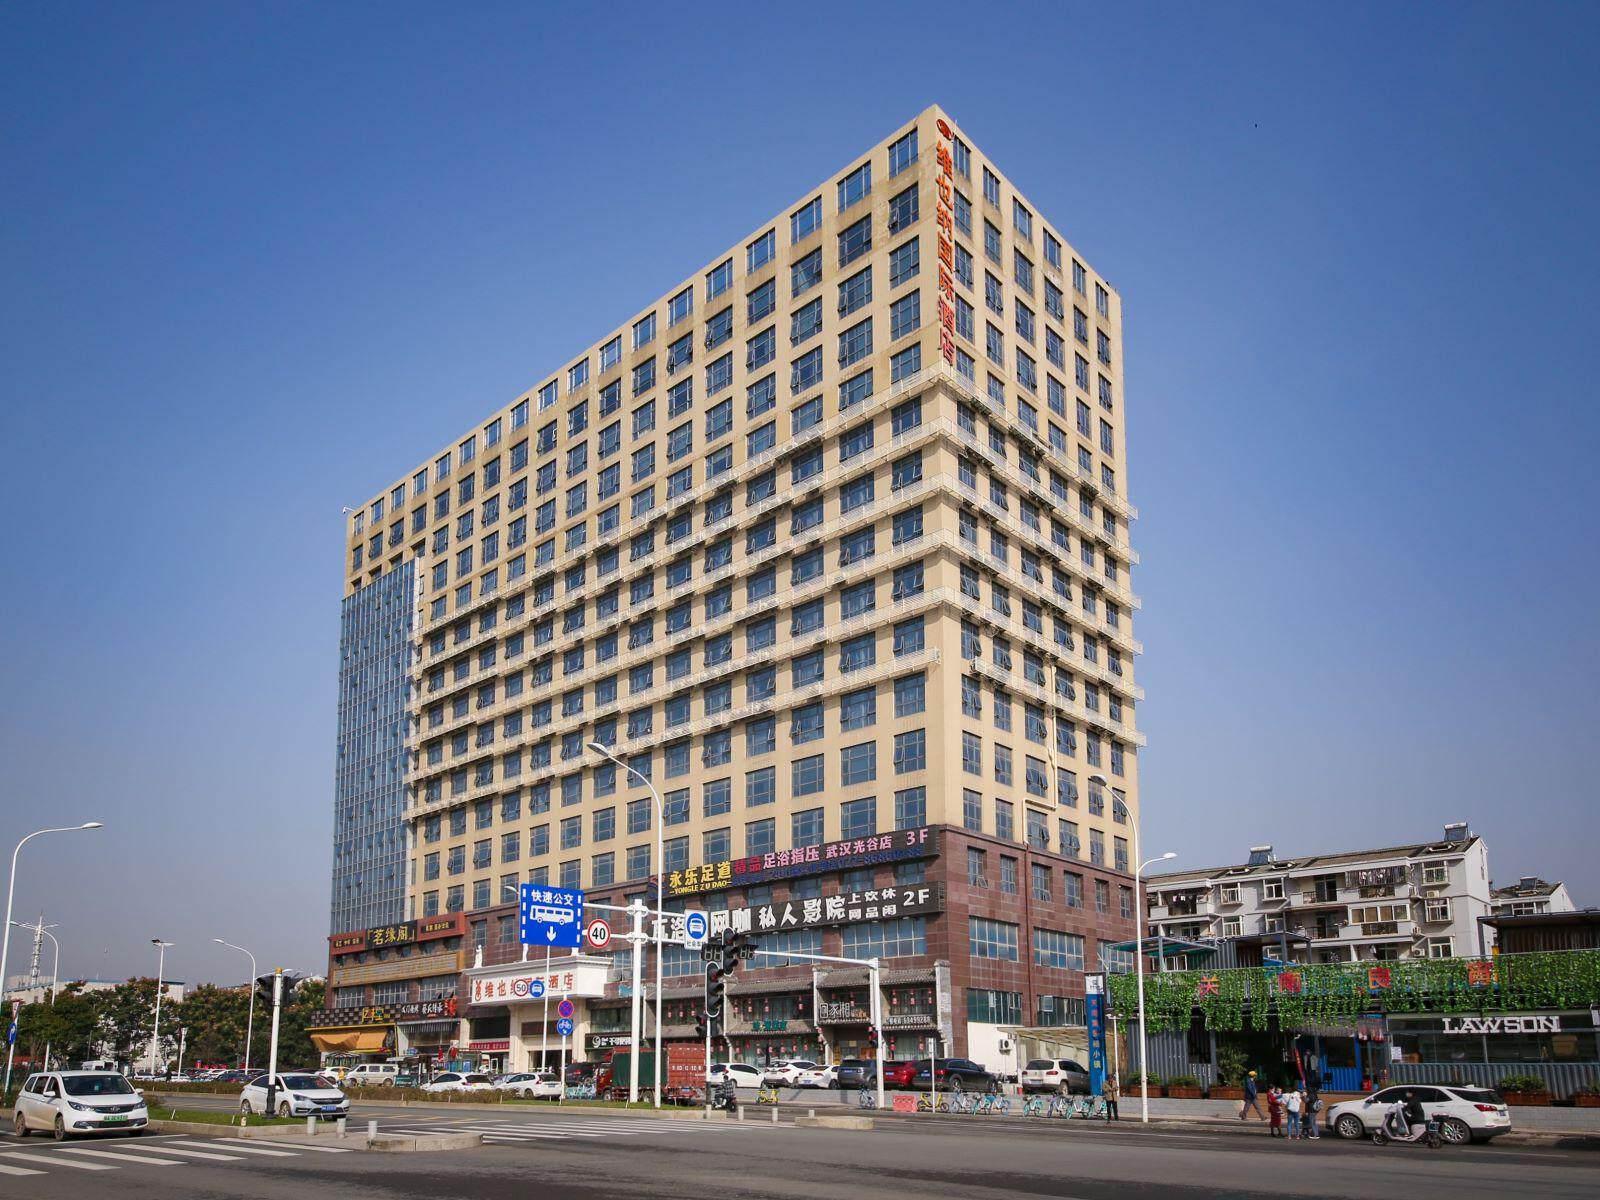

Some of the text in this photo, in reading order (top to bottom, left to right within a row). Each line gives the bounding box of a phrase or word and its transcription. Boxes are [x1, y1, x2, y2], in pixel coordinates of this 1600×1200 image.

[669, 861, 731, 888] 永乐足道
[825, 836, 892, 859] 武汉光谷店
[906, 829, 929, 846] 3F
[531, 889, 574, 906] 快速公交
[903, 888, 930, 906] 2F
[758, 896, 846, 930] 私人影院
[592, 927, 606, 940] 40
[516, 984, 526, 992] 50
[1442, 1016, 1562, 1034] LAWSON
